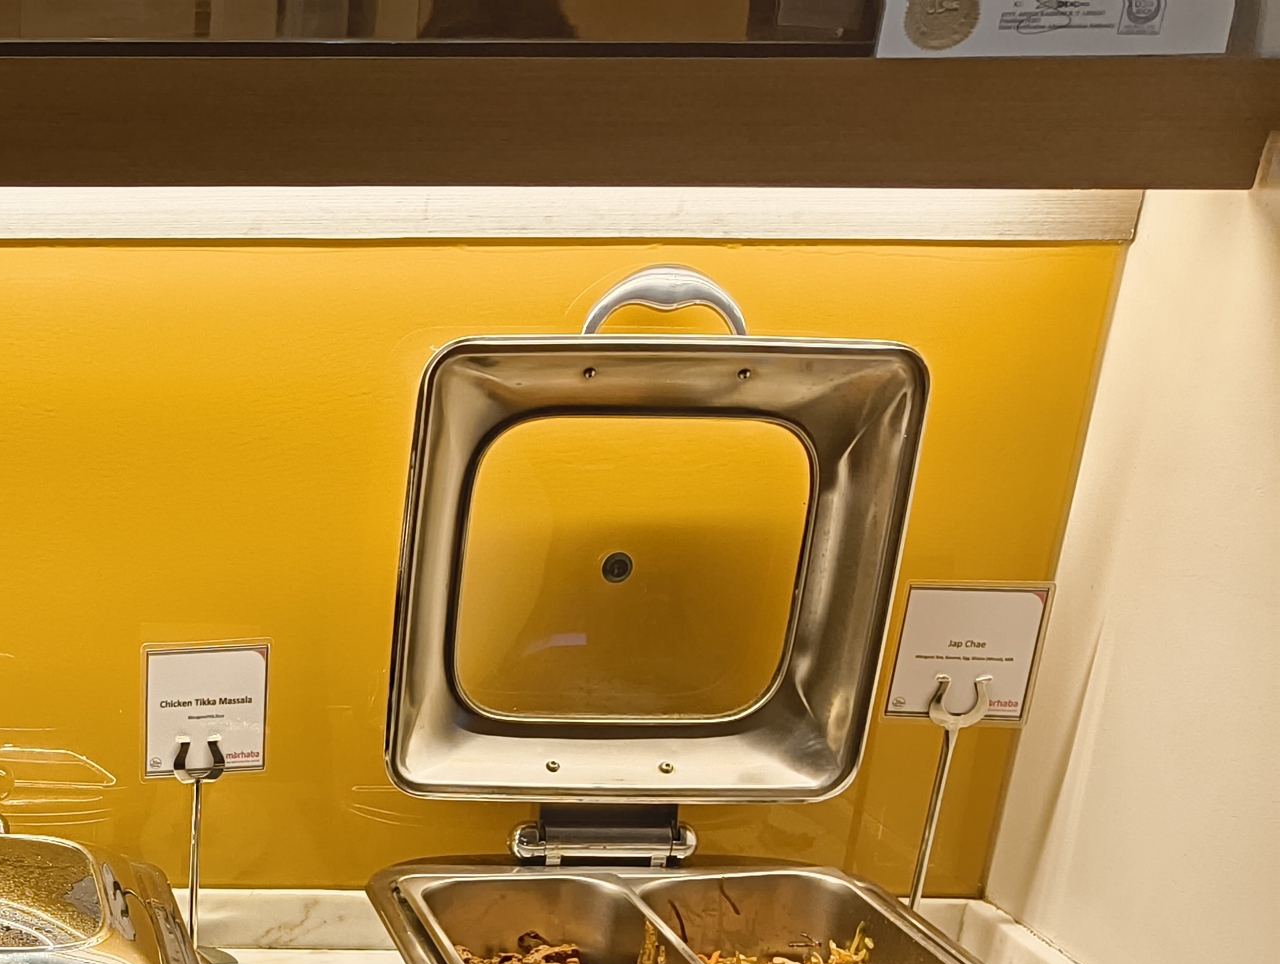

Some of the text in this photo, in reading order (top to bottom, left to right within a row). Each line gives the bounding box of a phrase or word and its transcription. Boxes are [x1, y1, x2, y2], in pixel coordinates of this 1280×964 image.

[948, 640, 986, 649] Jap Chae
[160, 695, 253, 708] Chicken Tikka Massala
